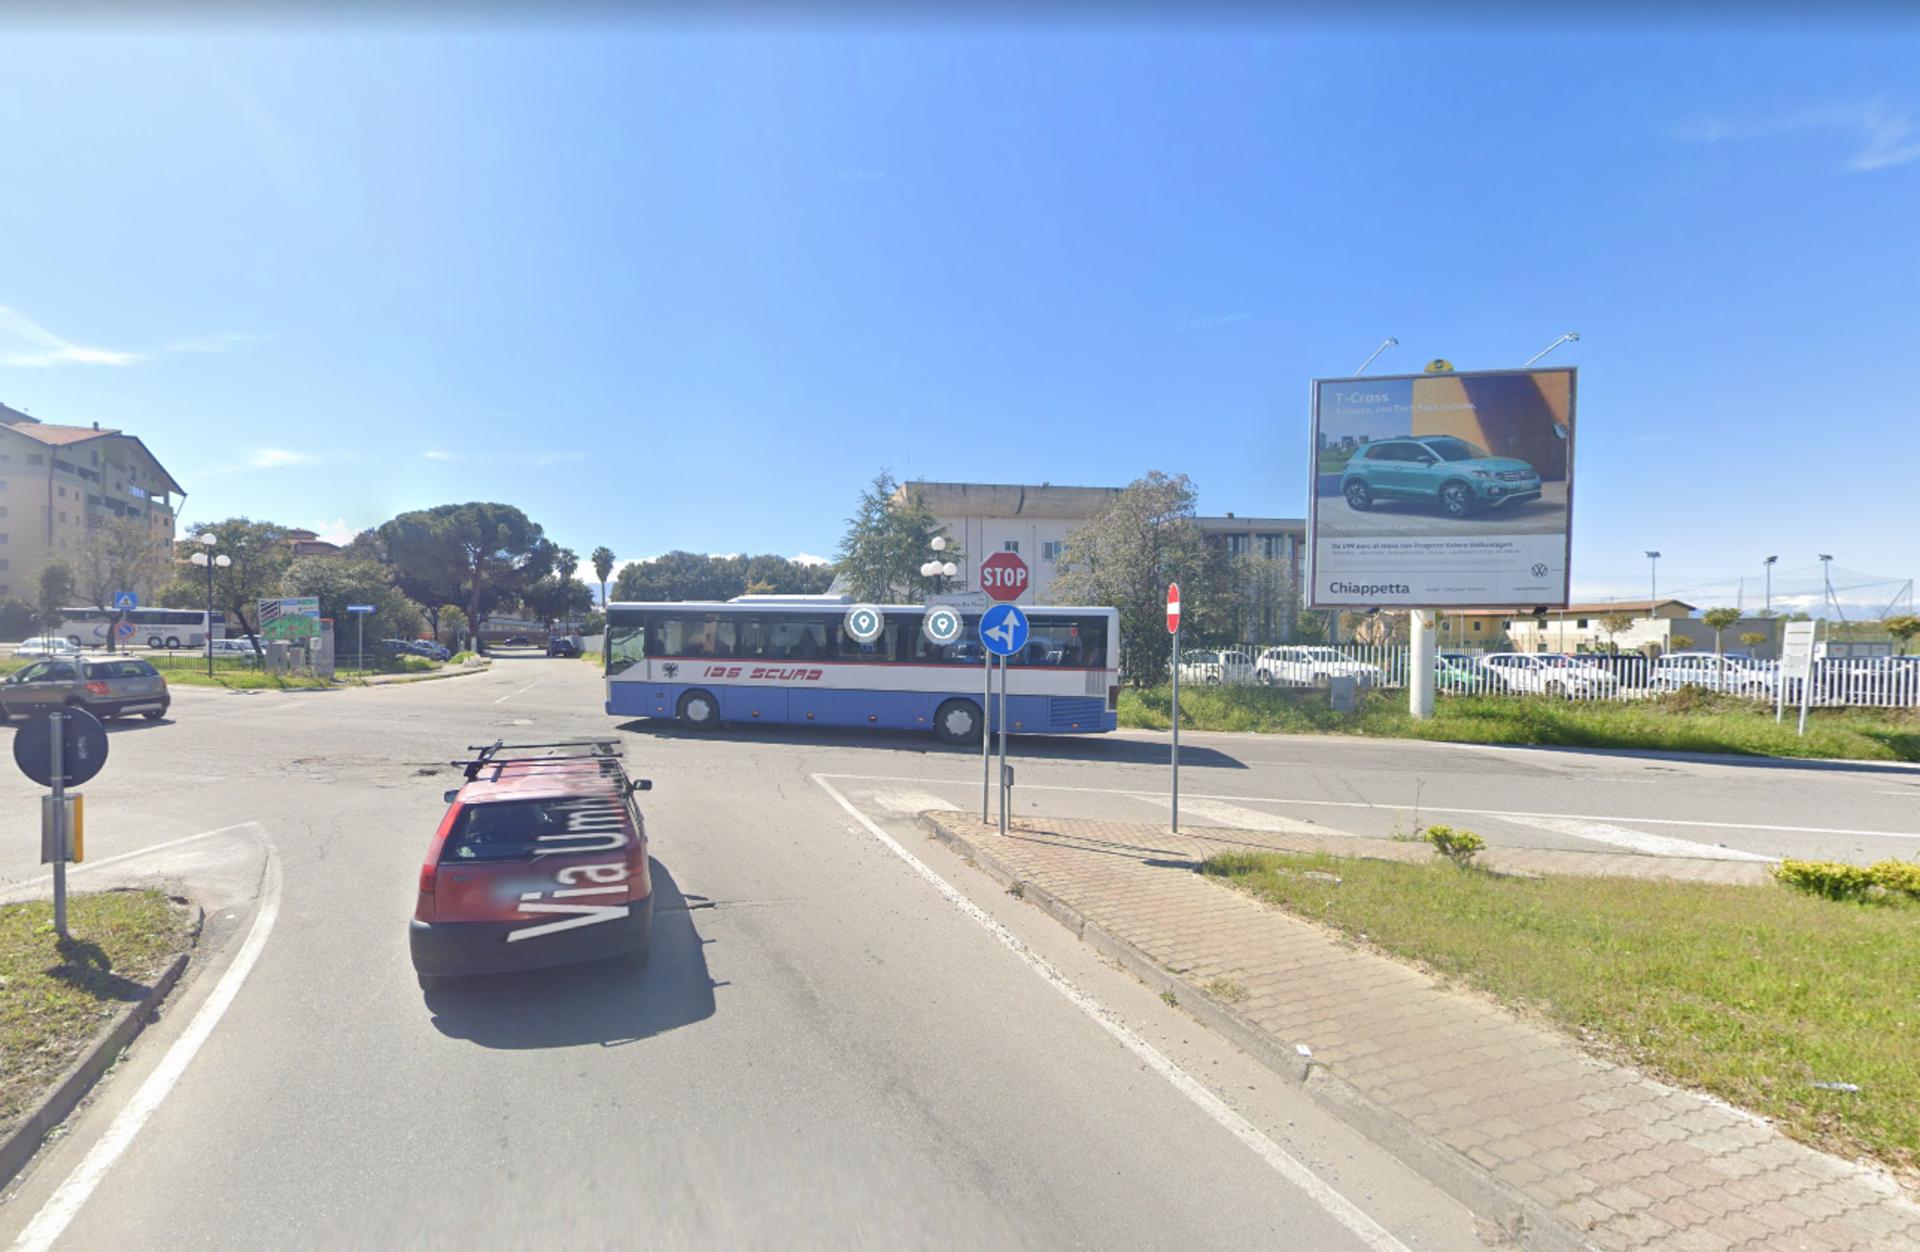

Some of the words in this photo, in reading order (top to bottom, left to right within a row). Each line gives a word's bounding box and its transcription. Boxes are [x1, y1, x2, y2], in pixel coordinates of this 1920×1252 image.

[1335, 391, 1389, 404] T-Cross
[983, 567, 1026, 587] STOP
[1329, 581, 1410, 597] Chiappetta
